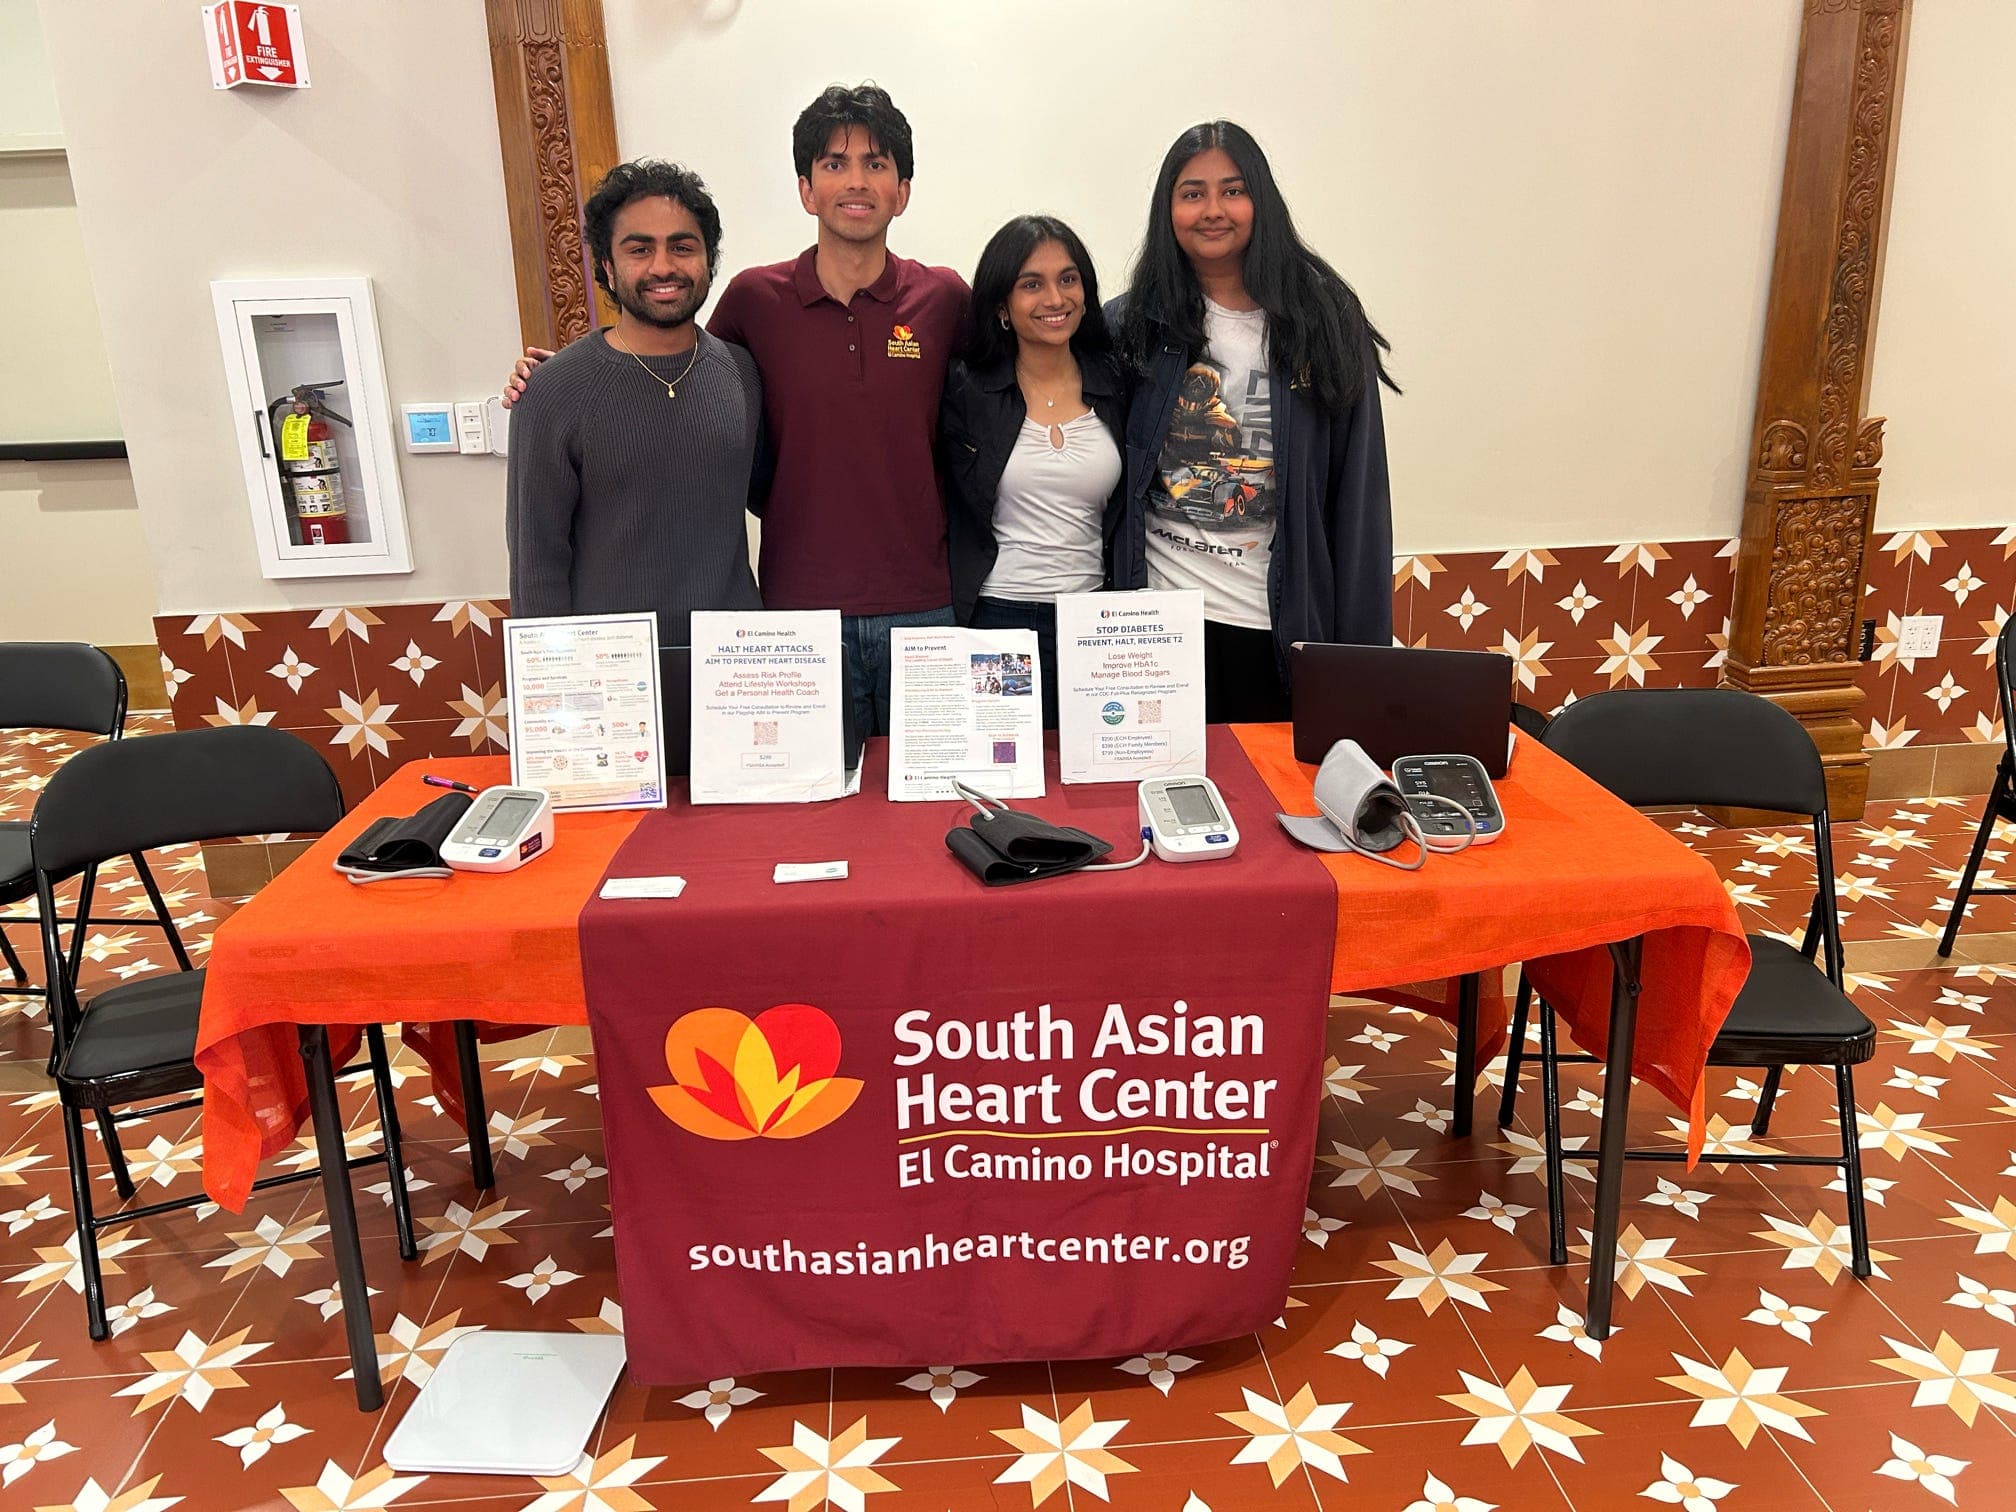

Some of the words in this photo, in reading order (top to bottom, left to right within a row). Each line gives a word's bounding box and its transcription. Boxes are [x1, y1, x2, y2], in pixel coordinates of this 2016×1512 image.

[256, 45, 278, 58] FIRE
[246, 55, 291, 67] EXTINGUISHER
[1152, 528, 1242, 557] McLaren
[1096, 626, 1118, 634] STOP
[1121, 624, 1164, 633] DIABETES
[1078, 639, 1114, 647] PREVENT,
[1128, 652, 1152, 660] Weight
[1145, 670, 1170, 678] Sugars
[892, 1004, 1074, 1066] South
[1091, 1000, 1264, 1058] Asian
[895, 1073, 1062, 1130] Heart
[1080, 1066, 1278, 1122] Center
[898, 1145, 935, 1188] El
[944, 1144, 1093, 1182] Camino
[689, 1231, 1251, 1277] southasianheartcenter.org
